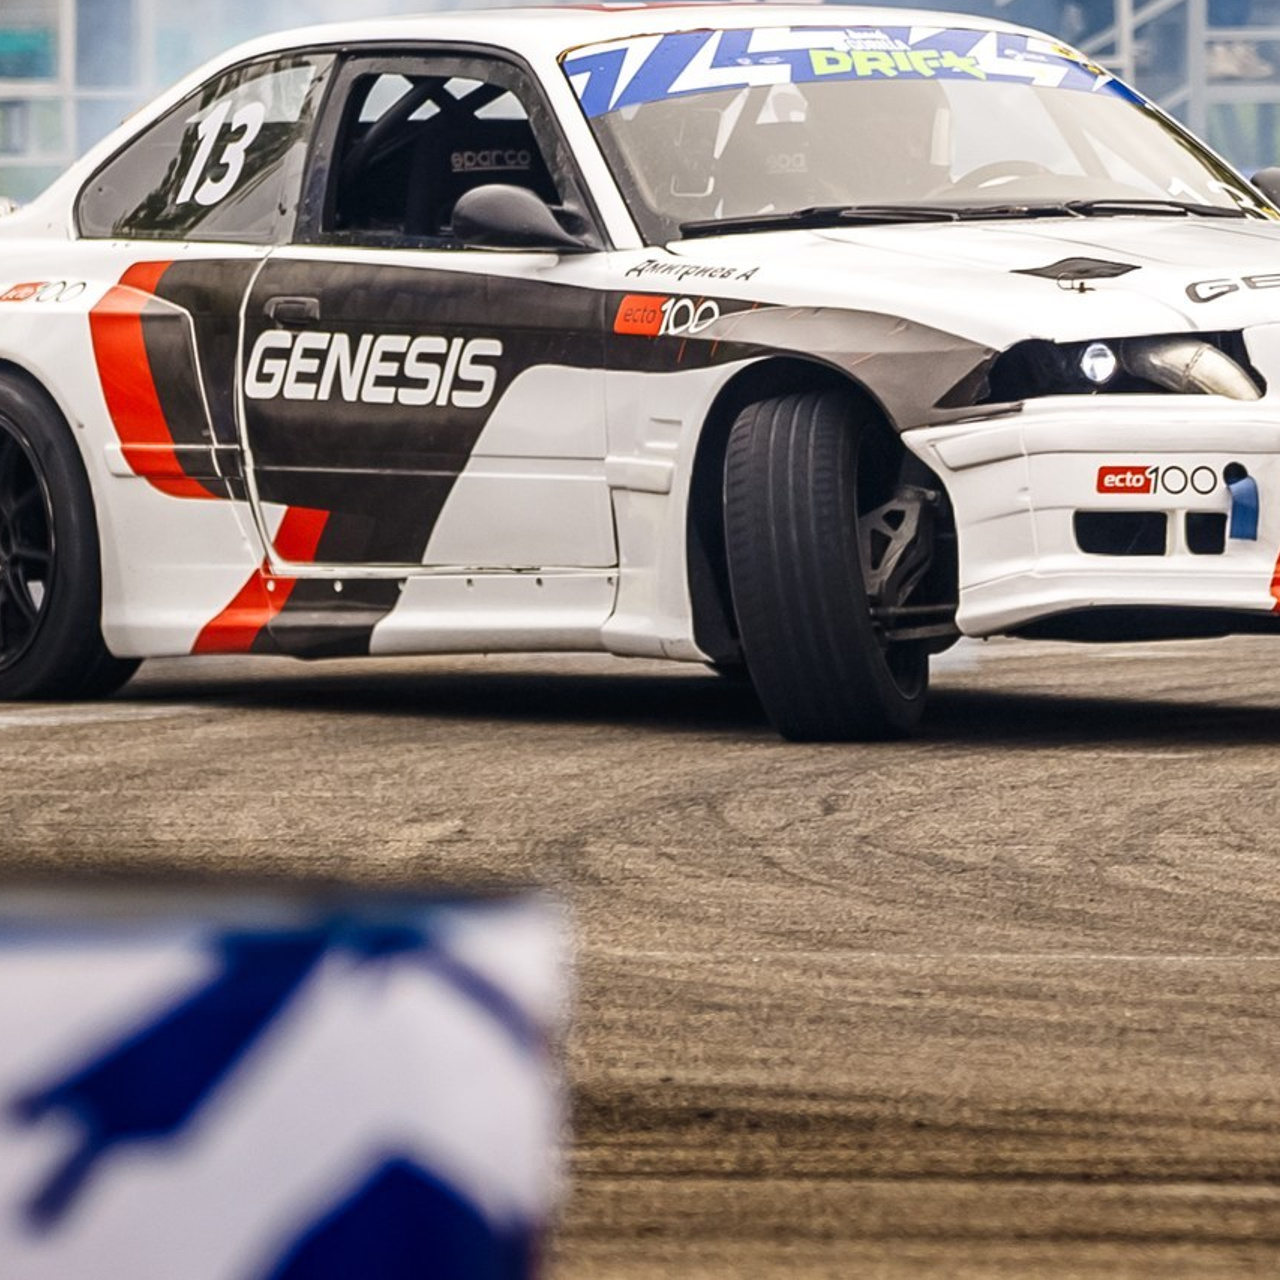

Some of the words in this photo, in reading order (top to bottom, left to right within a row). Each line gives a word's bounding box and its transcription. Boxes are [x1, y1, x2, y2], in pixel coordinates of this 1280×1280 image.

[808, 47, 987, 81] DRIFT
[176, 100, 265, 207] 13
[450, 148, 531, 172] sparco
[623, 297, 720, 336] ecto100
[245, 329, 503, 408] GENESIS
[1103, 465, 1218, 495] ecto100
